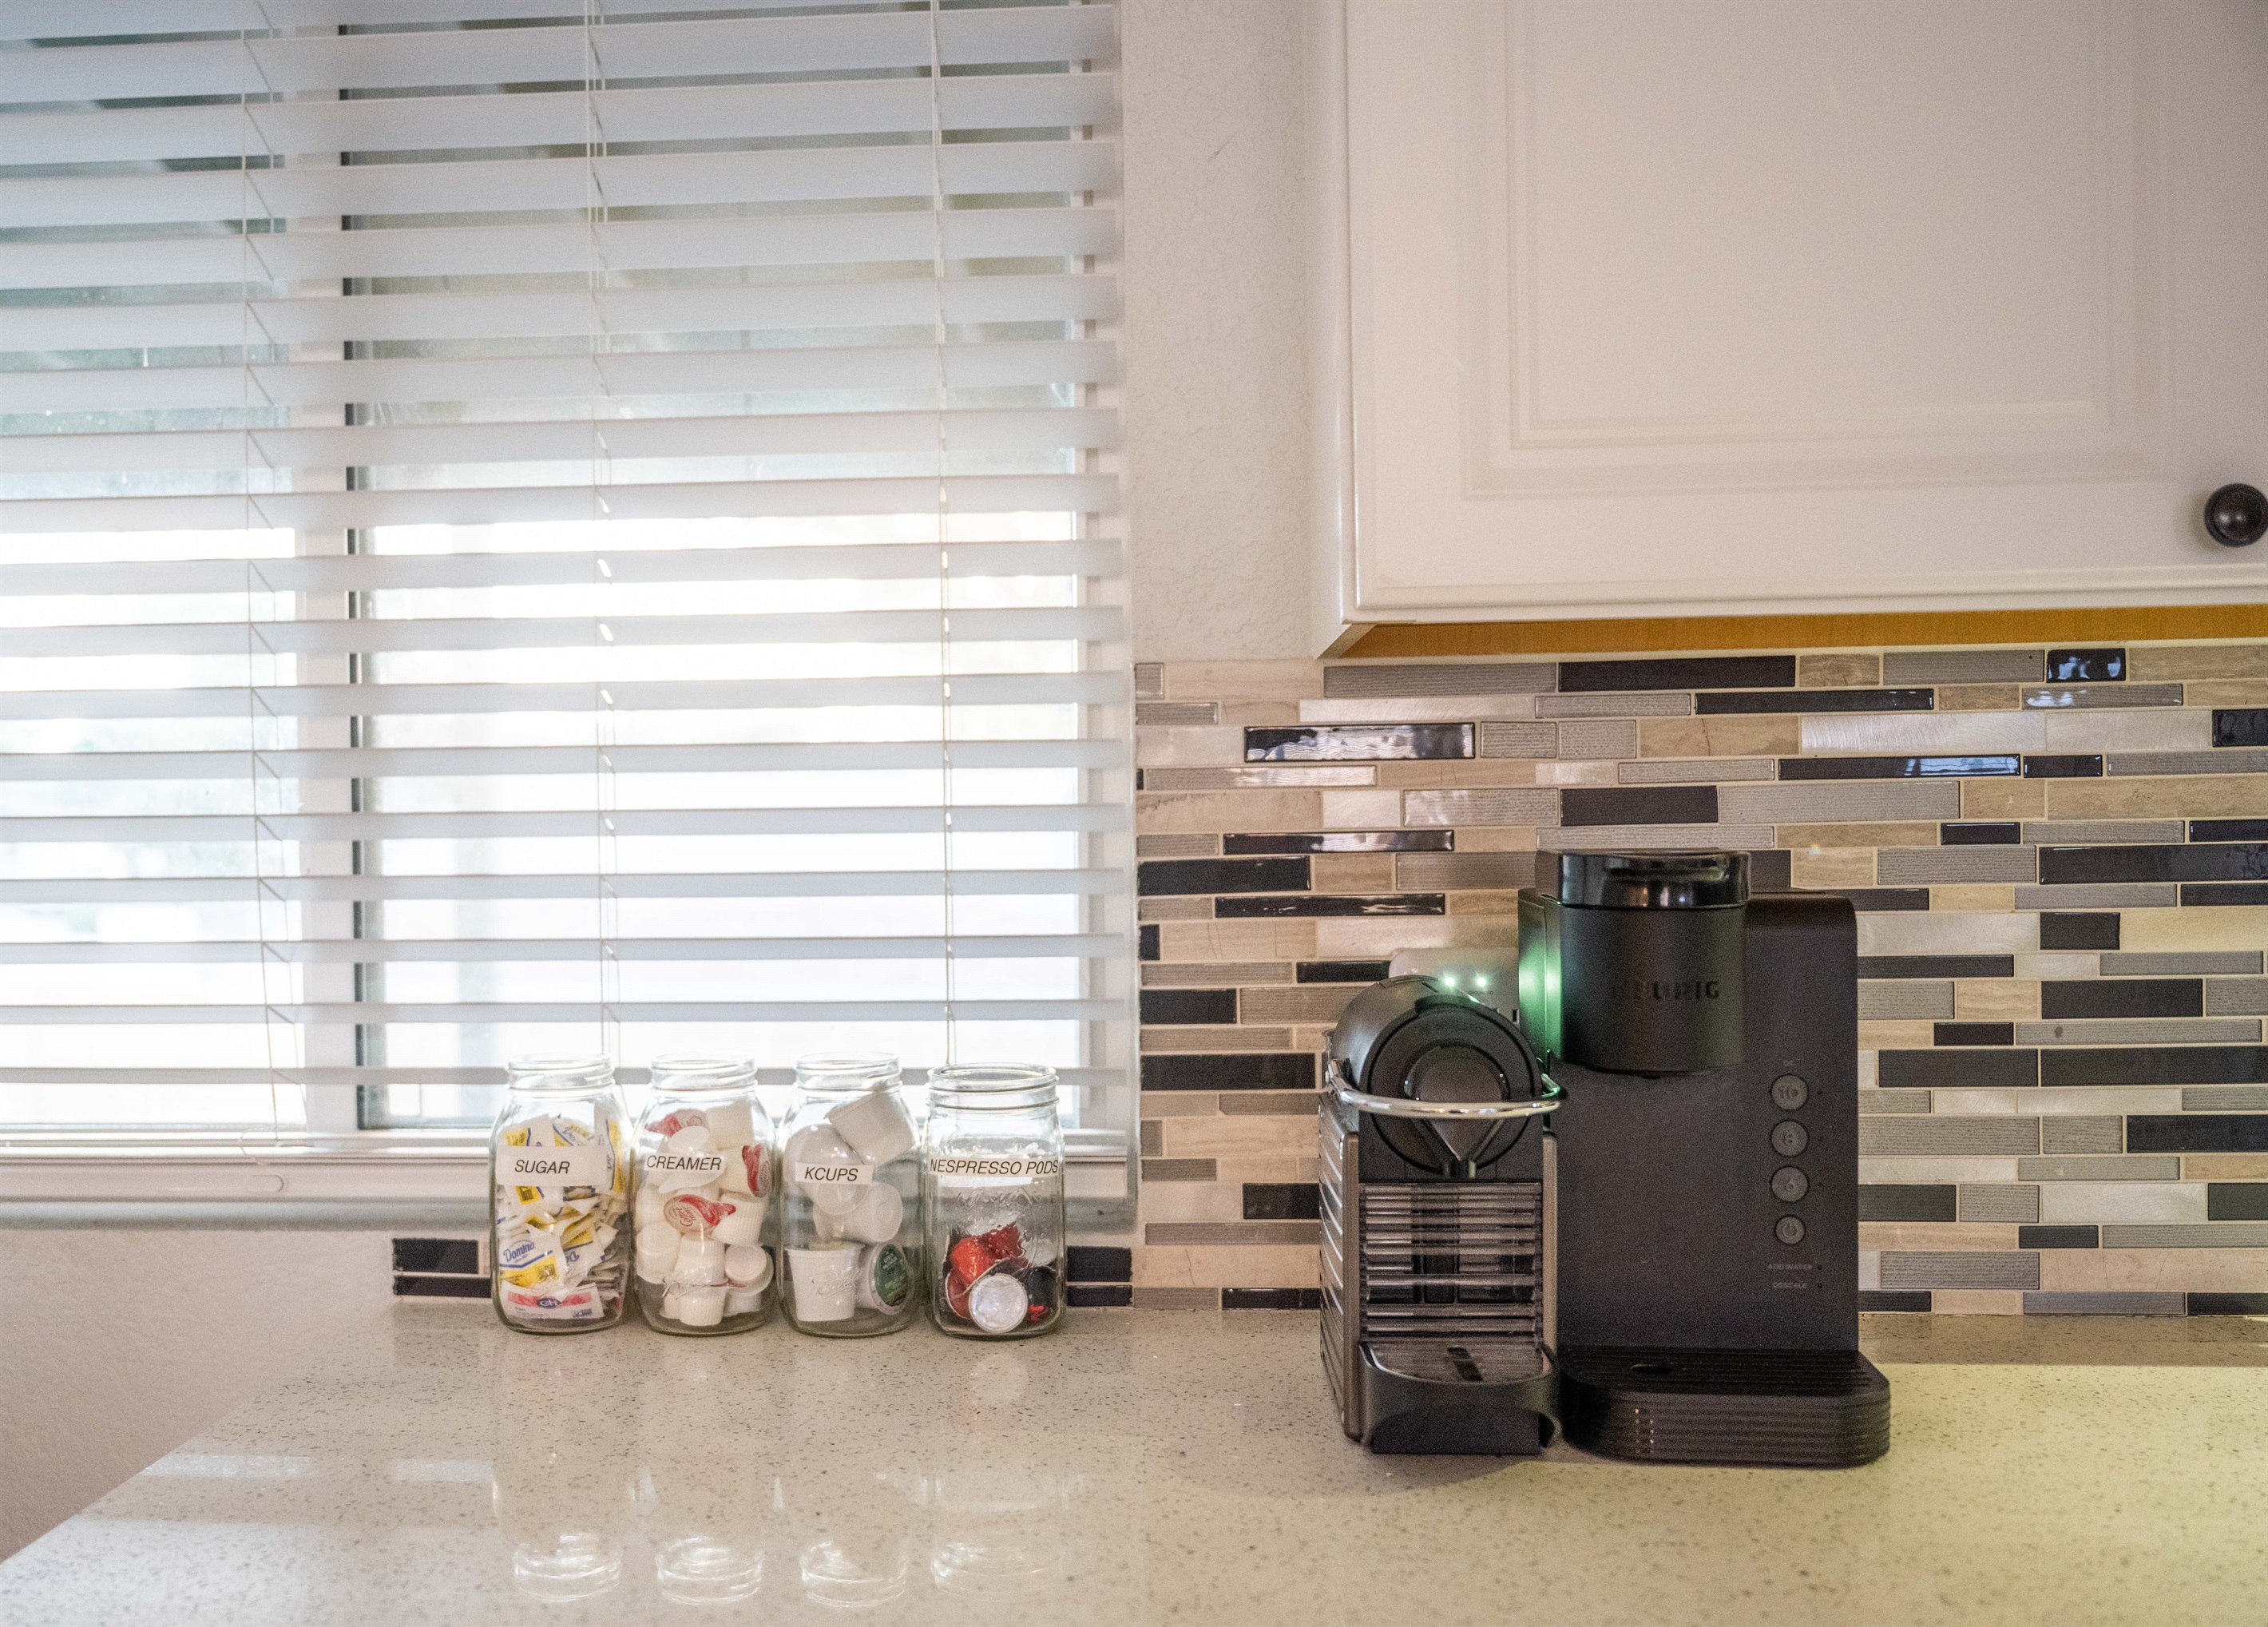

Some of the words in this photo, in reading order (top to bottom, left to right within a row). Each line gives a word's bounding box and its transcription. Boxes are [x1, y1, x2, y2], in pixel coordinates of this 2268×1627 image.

[514, 1159, 570, 1174] SUGAR
[646, 1155, 722, 1171] CREAMER
[930, 1159, 1022, 1175] NESPRESSO
[803, 1166, 858, 1182] KCUPS
[503, 1241, 536, 1263] Domino
